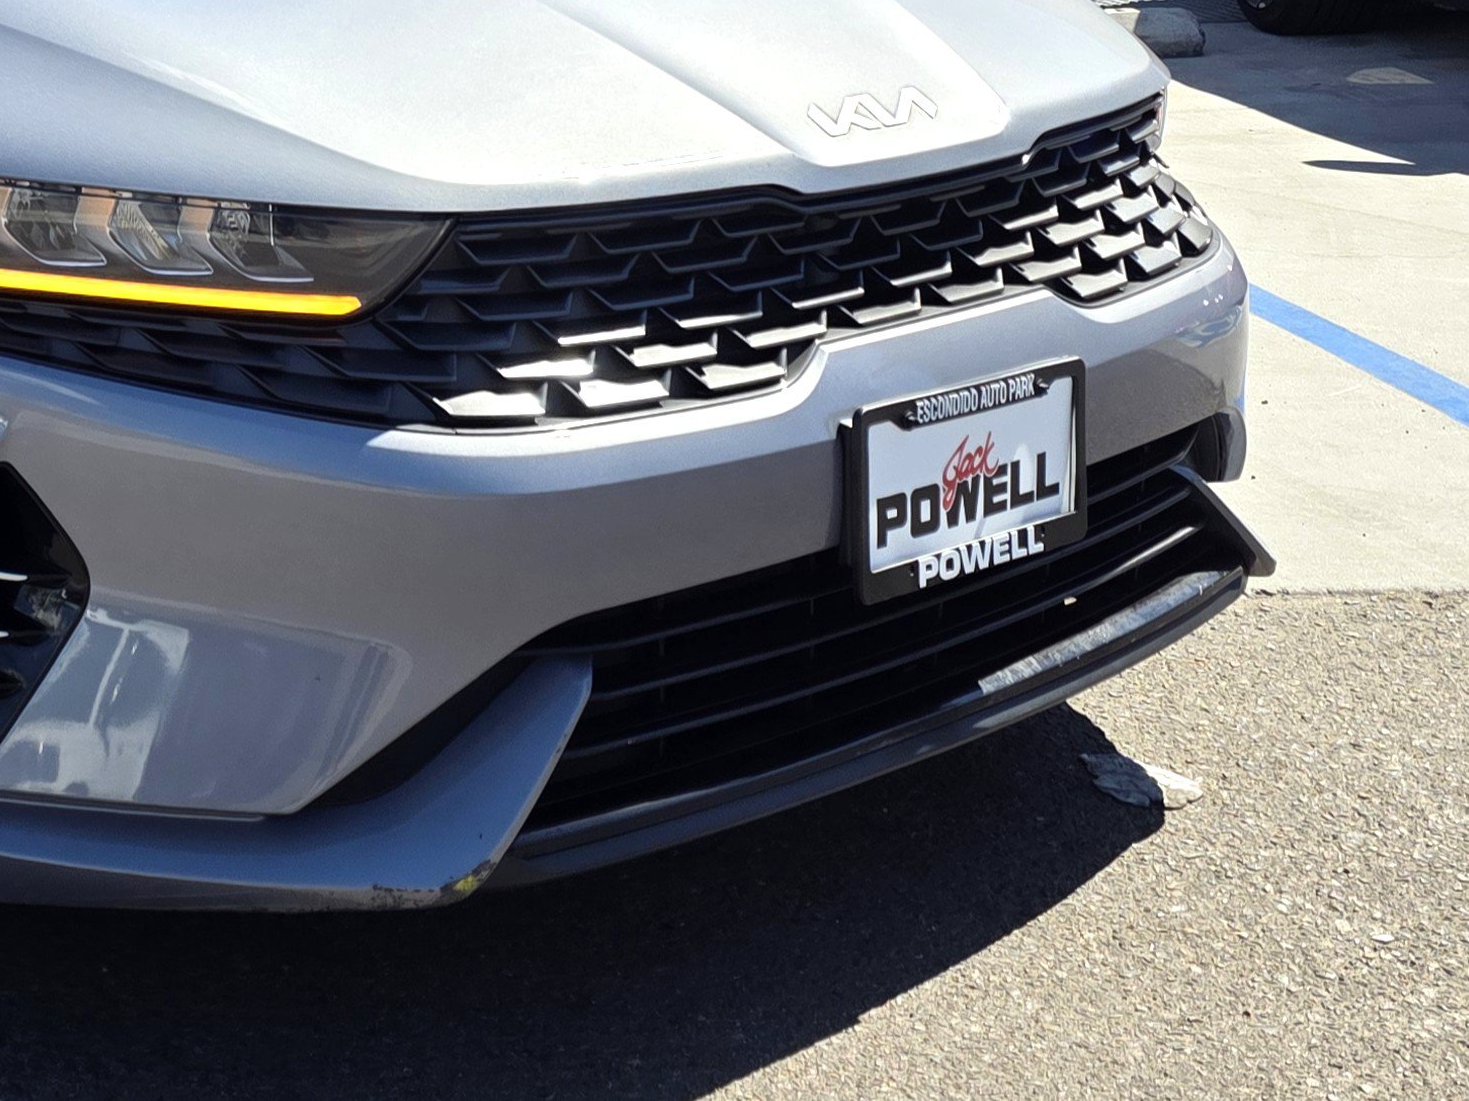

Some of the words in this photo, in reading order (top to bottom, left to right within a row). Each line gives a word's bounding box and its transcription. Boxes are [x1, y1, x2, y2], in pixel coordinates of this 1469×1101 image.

[915, 387, 979, 425] ESCONDIDO
[980, 379, 1008, 410] AUTO
[1008, 373, 1035, 403] PARK
[876, 451, 1060, 550] POWELL
[942, 431, 1000, 511] Jack
[917, 524, 1044, 589] POWELL
